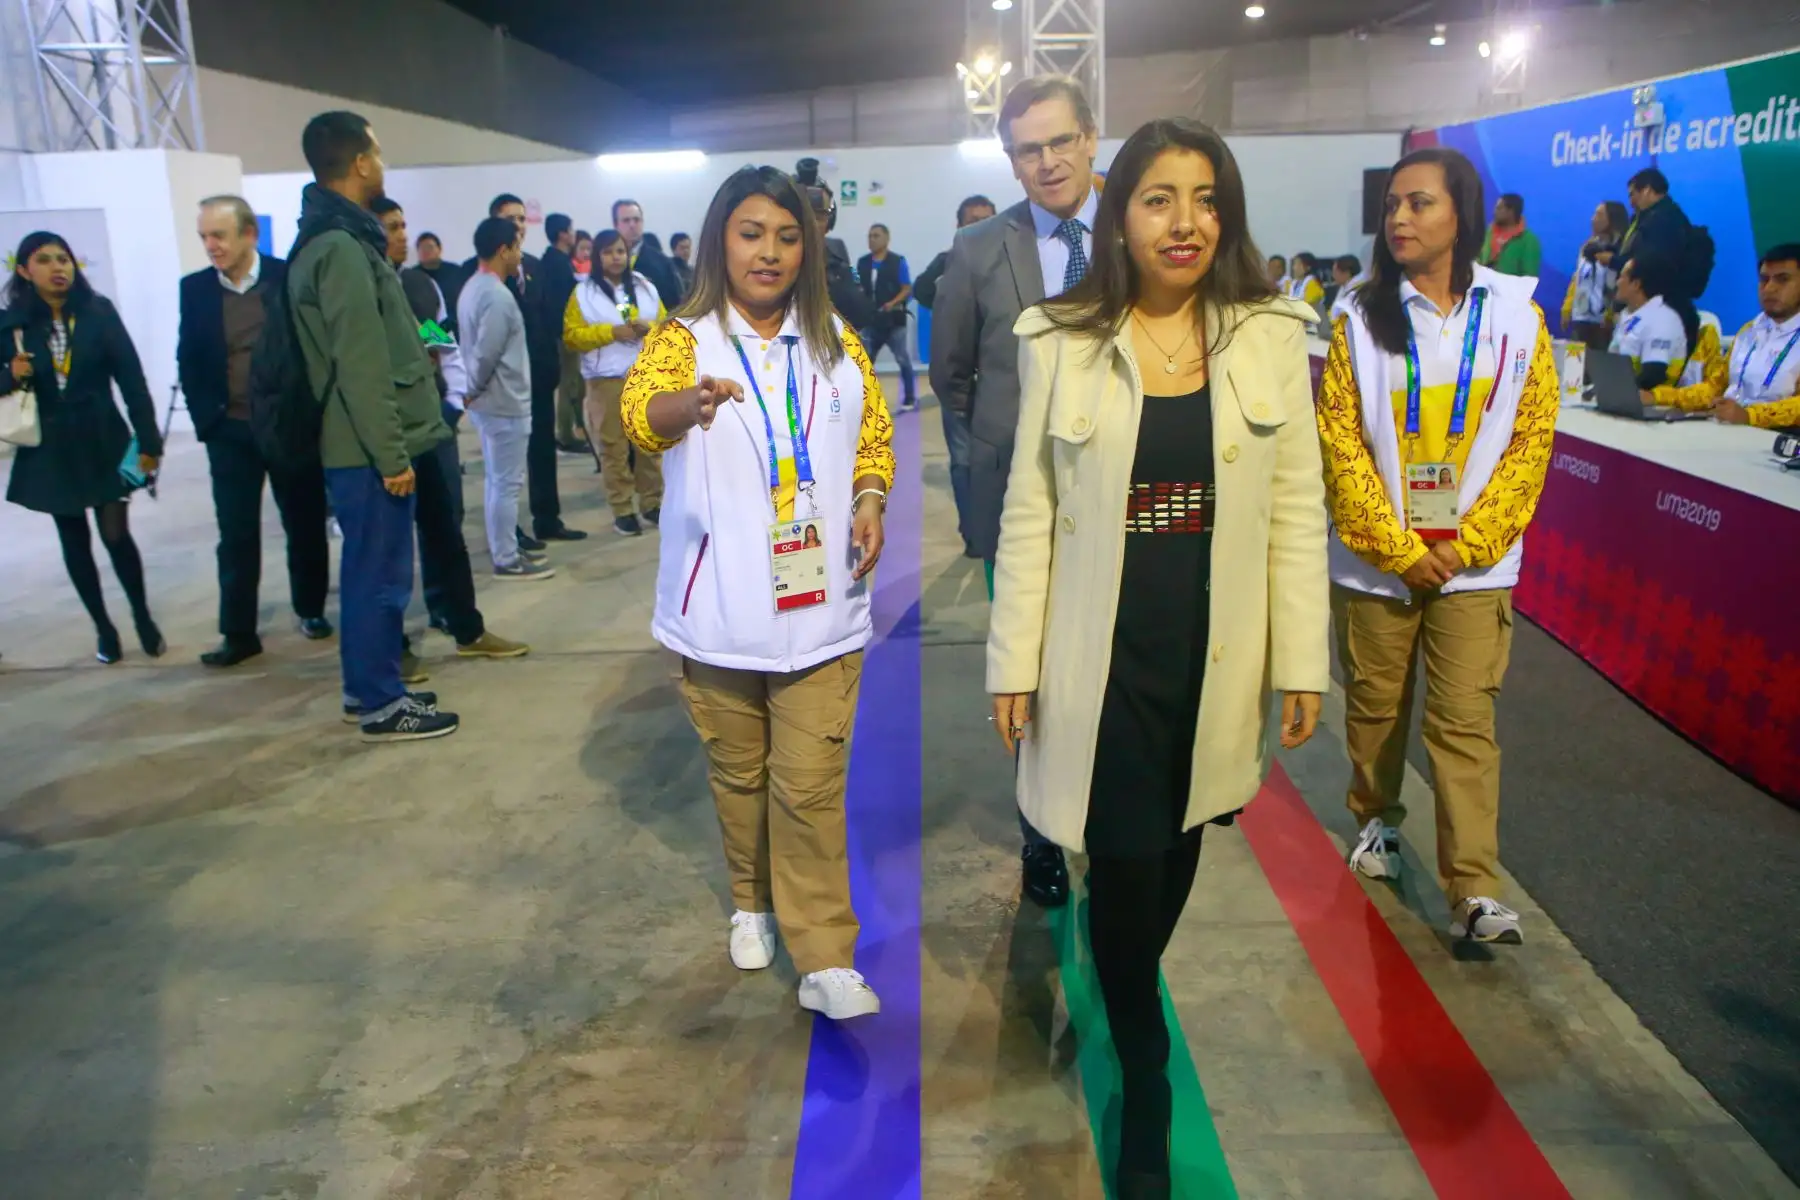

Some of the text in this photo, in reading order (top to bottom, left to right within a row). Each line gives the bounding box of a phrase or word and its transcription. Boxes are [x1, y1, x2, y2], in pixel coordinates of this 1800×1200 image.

[1551, 95, 1800, 168] Check-in de acredit
[782, 543, 793, 551] OC
[815, 592, 822, 601] R
